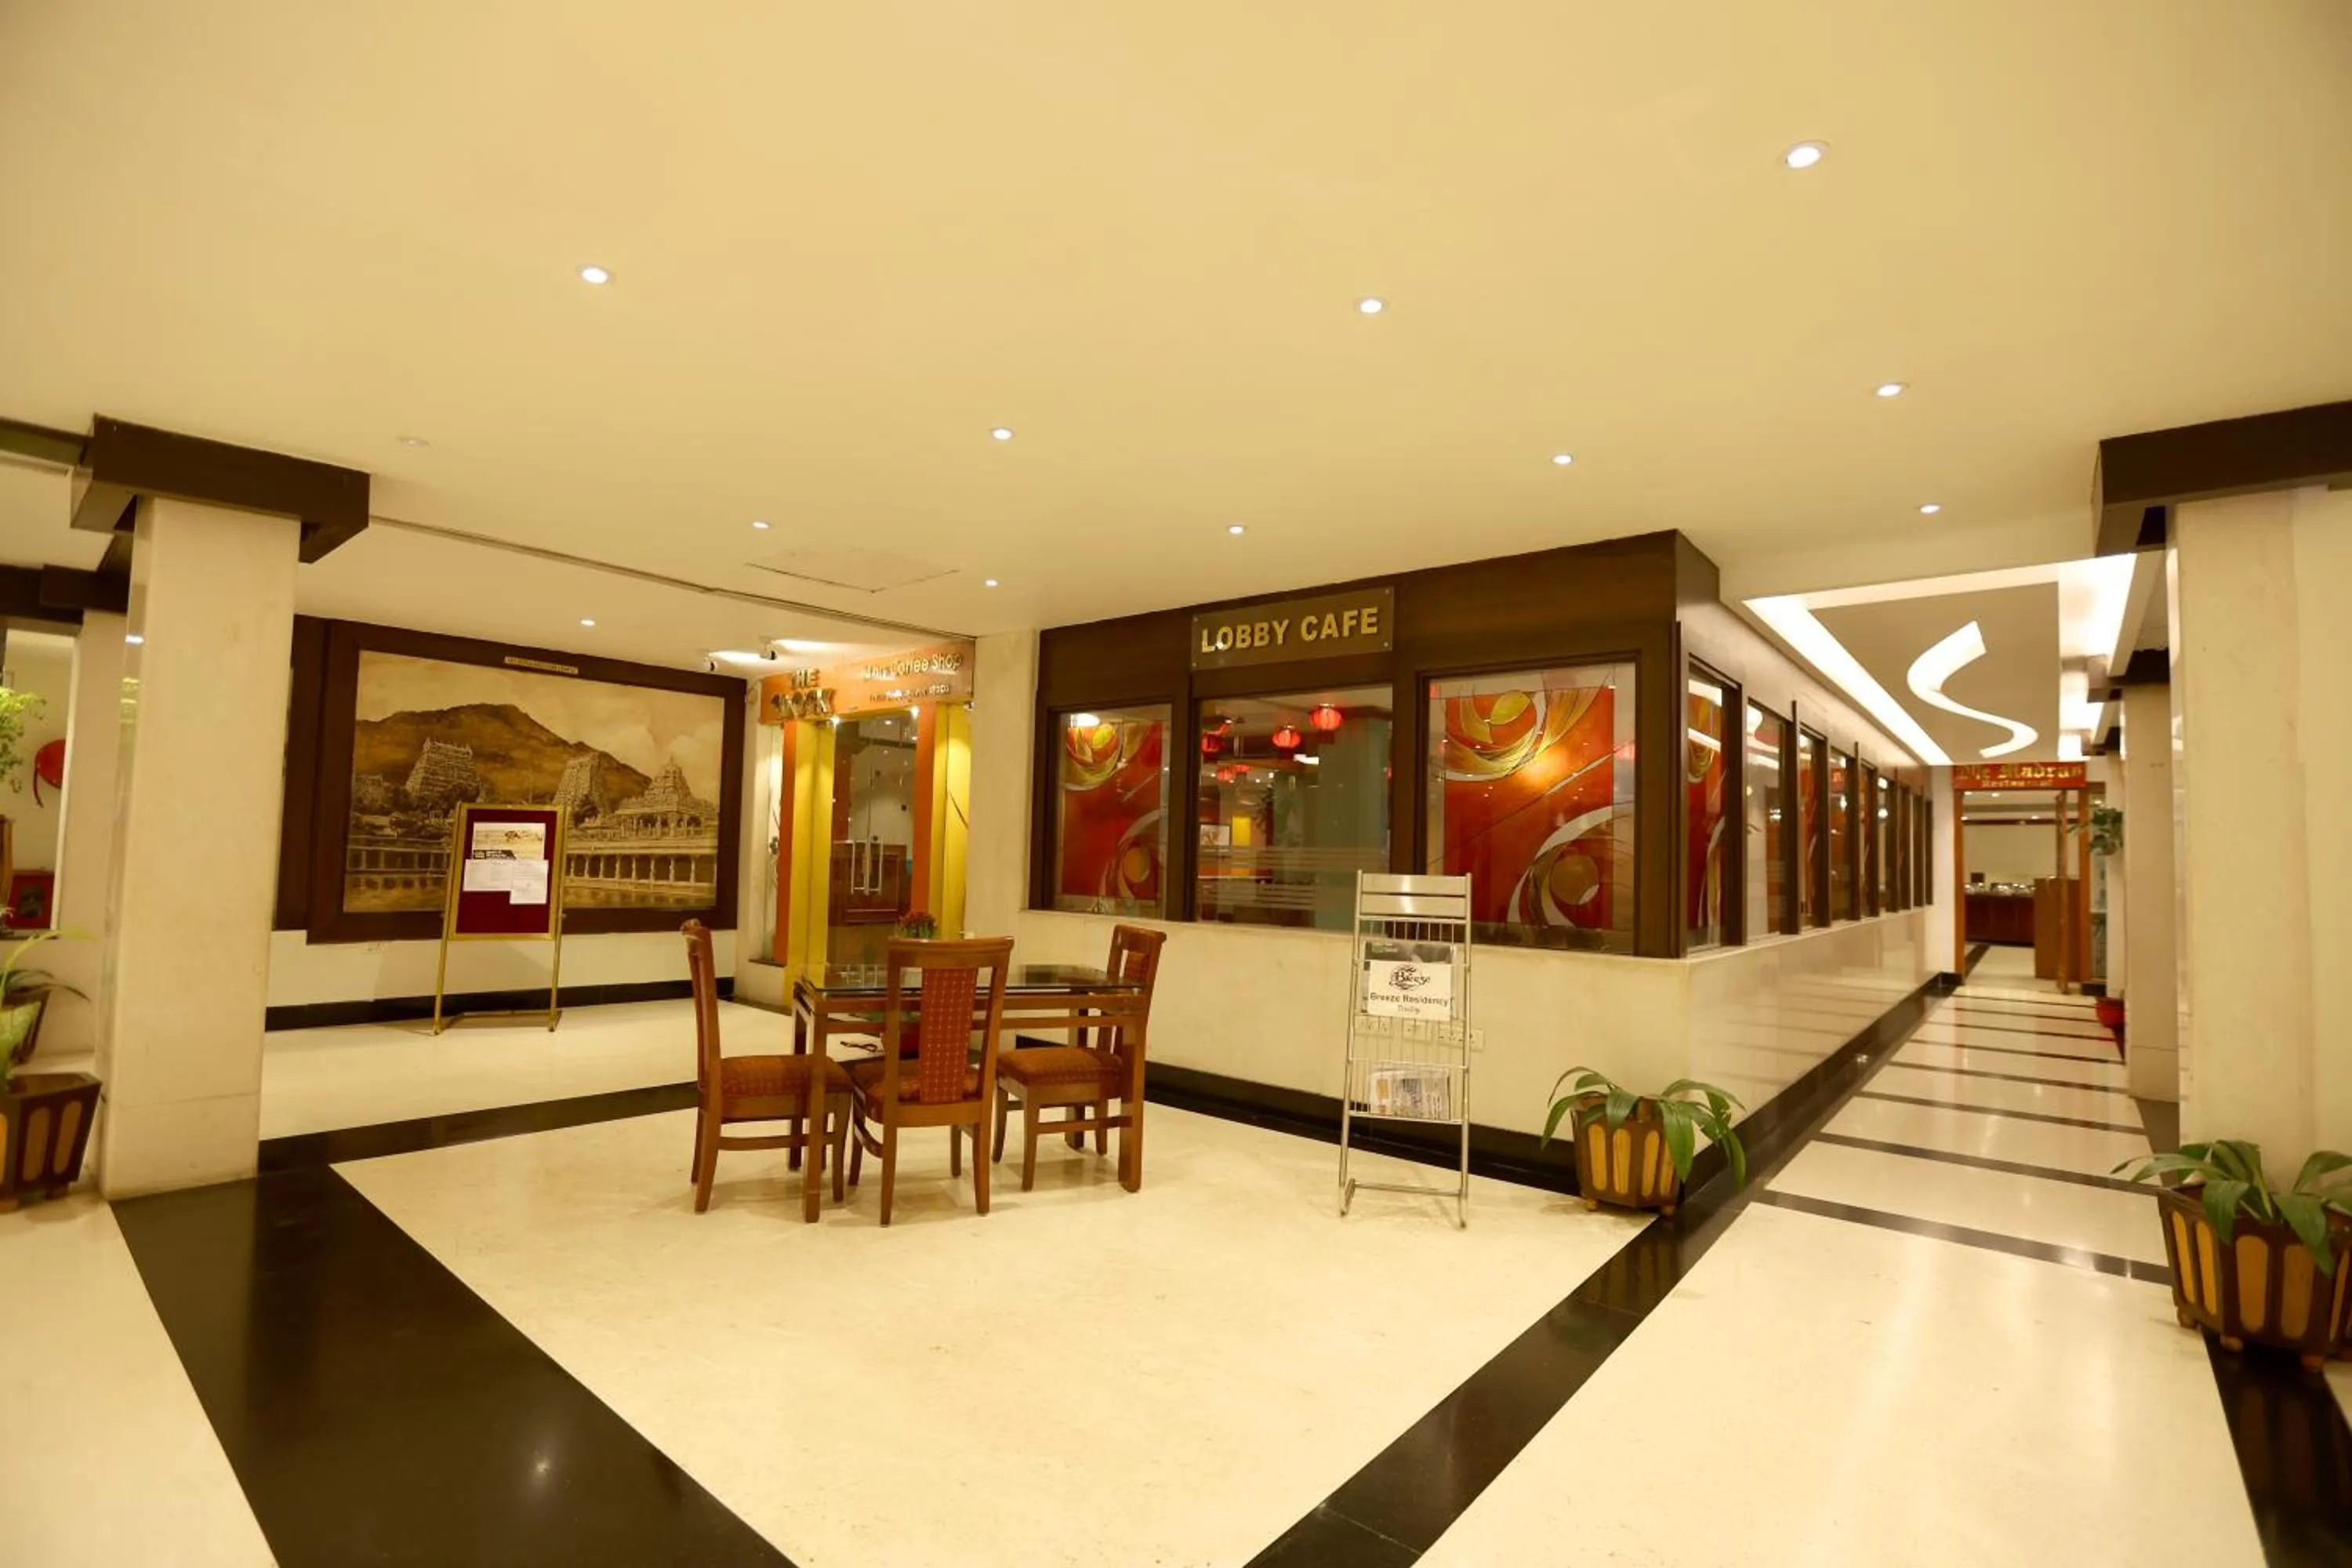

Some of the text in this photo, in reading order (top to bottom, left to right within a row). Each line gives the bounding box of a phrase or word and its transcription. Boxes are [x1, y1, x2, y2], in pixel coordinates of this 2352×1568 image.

[1201, 607, 1378, 653] LOBBY CAFE
[931, 652, 963, 672] Shop
[1370, 993, 1449, 1007] Breeze Residency
